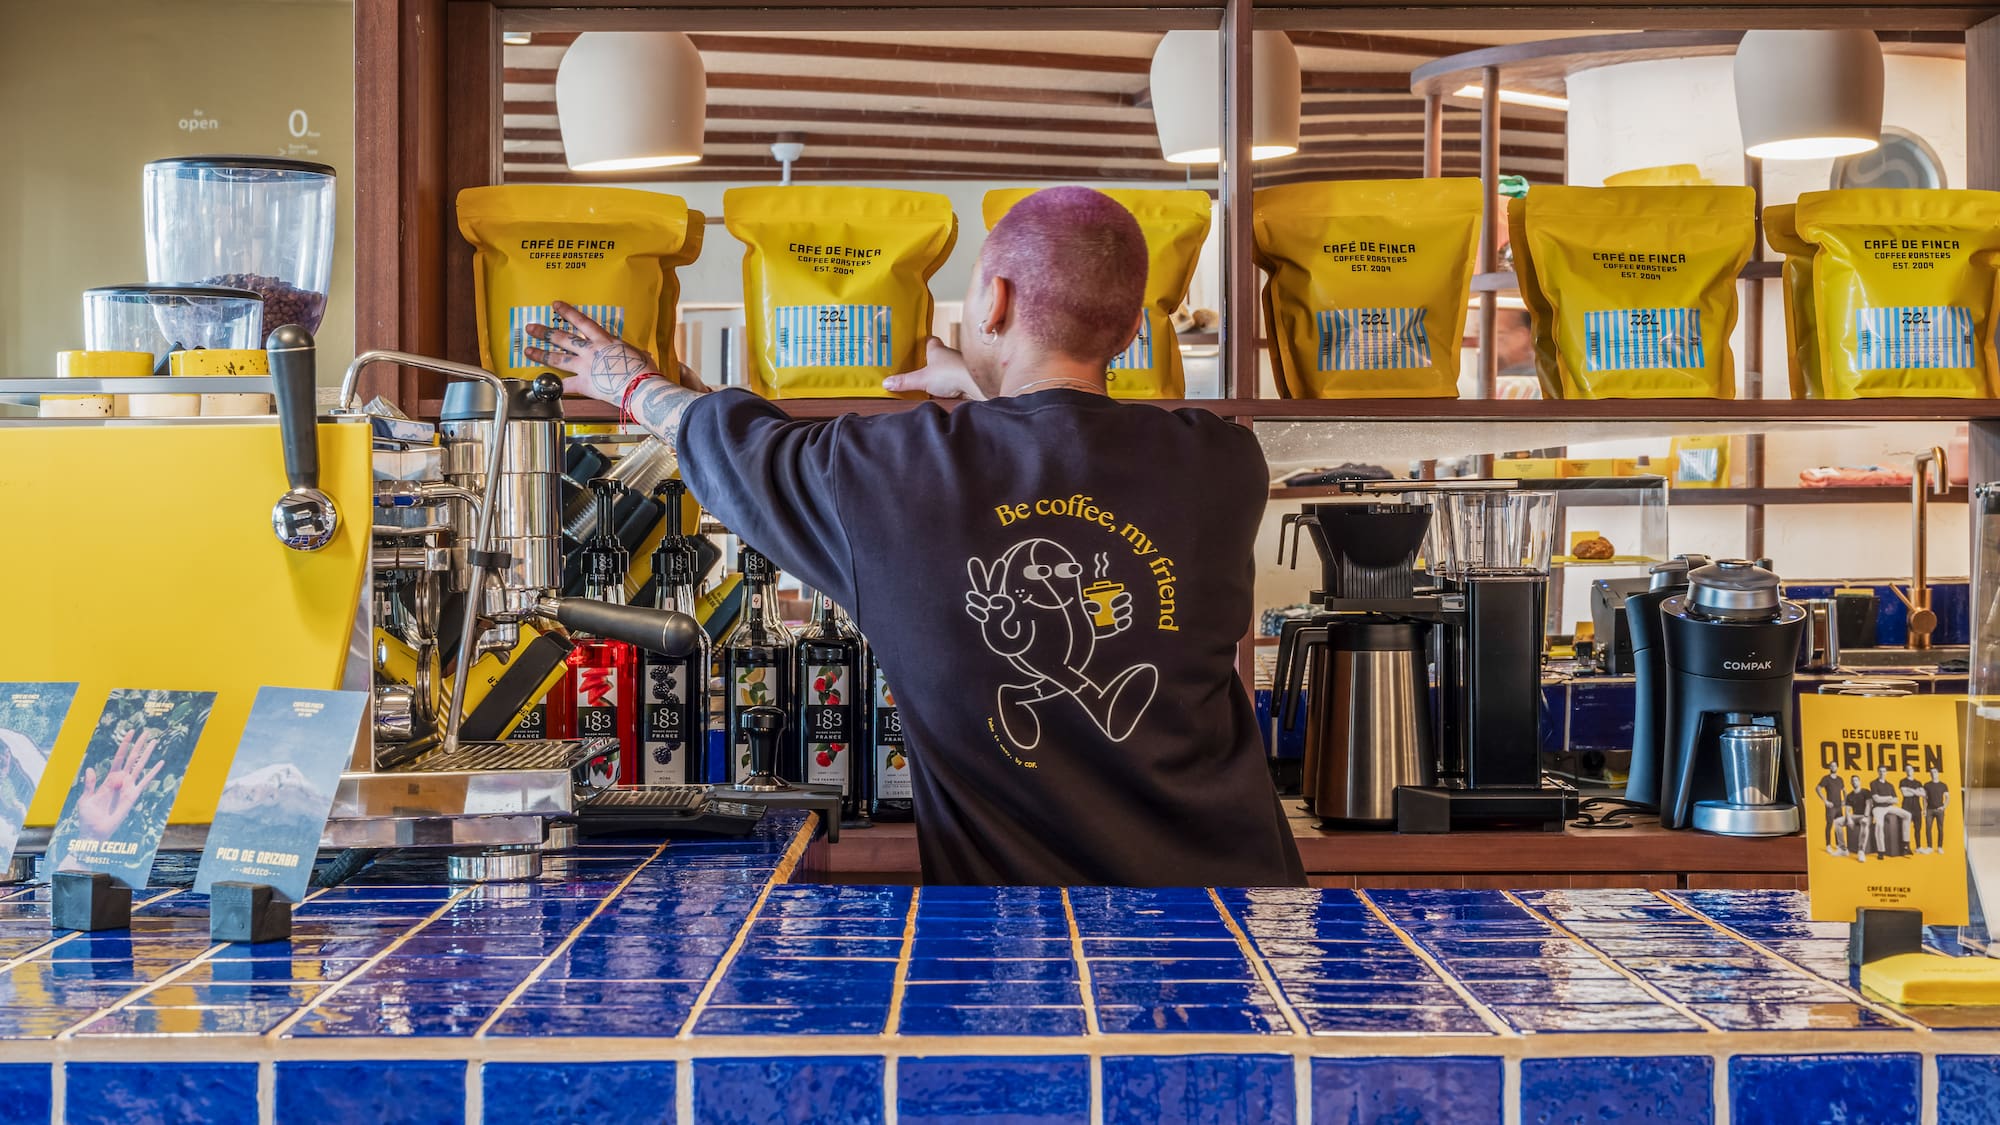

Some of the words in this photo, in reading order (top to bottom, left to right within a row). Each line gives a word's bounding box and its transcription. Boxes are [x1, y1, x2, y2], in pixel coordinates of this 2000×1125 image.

[178, 118, 219, 132] open
[521, 238, 554, 250] CAFÉ
[558, 240, 573, 250] DE
[577, 240, 616, 250] FINCA
[1323, 242, 1356, 254] CAFÉ
[1360, 242, 1376, 252] DE
[1379, 243, 1416, 254] FINCA
[1864, 238, 1898, 249] CAFÉ
[1902, 240, 1918, 249] DE
[1922, 240, 1960, 250] FINCA
[789, 243, 822, 255] CAFÉ
[825, 246, 842, 255] DE
[845, 248, 882, 258] FINCA
[798, 256, 830, 264] COFFEE
[830, 257, 871, 267] ROASTERS
[1366, 255, 1408, 264] ROASTERS
[1593, 252, 1625, 262] CAFÉ
[1629, 254, 1646, 262] DE
[1649, 254, 1686, 264] FINCA
[833, 267, 854, 275] 2009
[1636, 264, 1678, 272] ROASTERS
[994, 502, 1031, 526] Be
[1035, 494, 1117, 532] coffee,
[1120, 522, 1158, 556] my
[1149, 556, 1180, 632] friend
[1723, 660, 1772, 671] COMPAK
[1842, 728, 1901, 740] DESCUBRE
[1904, 730, 1919, 741] TU
[1820, 741, 1944, 773] ORIGEN
[67, 840, 99, 852] SANTA
[100, 841, 138, 855] CECILIA
[216, 847, 239, 861] PICO
[240, 849, 256, 863] DE
[256, 850, 299, 867] ORIZABA
